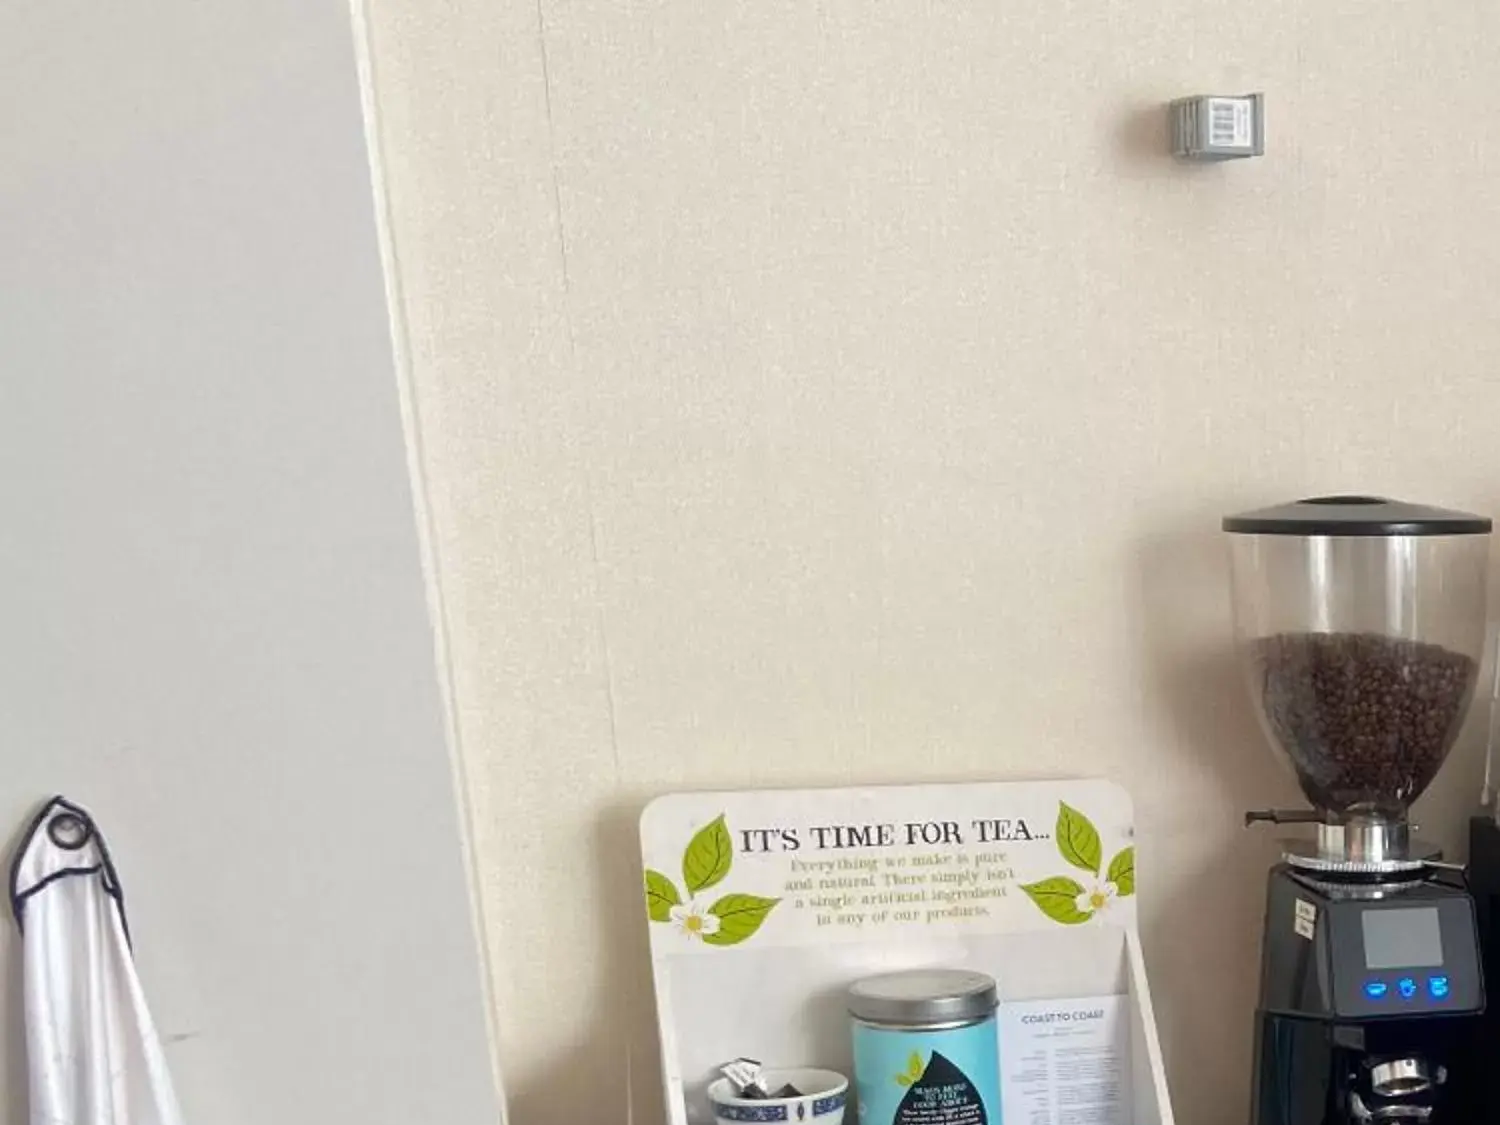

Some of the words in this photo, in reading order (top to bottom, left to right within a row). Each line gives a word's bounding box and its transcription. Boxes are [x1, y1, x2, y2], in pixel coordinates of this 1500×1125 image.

[740, 829, 801, 853] IT'S
[810, 824, 895, 849] TIME
[906, 820, 963, 845] FOR
[971, 818, 1051, 842] TEA...
[790, 855, 879, 873] Everything
[886, 857, 907, 867] we
[912, 853, 953, 867] make
[957, 853, 972, 865] is
[974, 852, 1008, 868] pure
[784, 877, 814, 891] and
[883, 872, 925, 887] There
[930, 870, 980, 886] simply
[986, 868, 1015, 881] isn't
[809, 893, 856, 910] single
[861, 890, 929, 906] artificial
[931, 886, 1008, 904] ingredient
[816, 912, 832, 926] in
[836, 912, 865, 927] any
[871, 909, 888, 922] of
[893, 909, 922, 922] our
[1021, 1013, 1056, 1025] COAST
[1072, 1009, 1105, 1021] COAST
